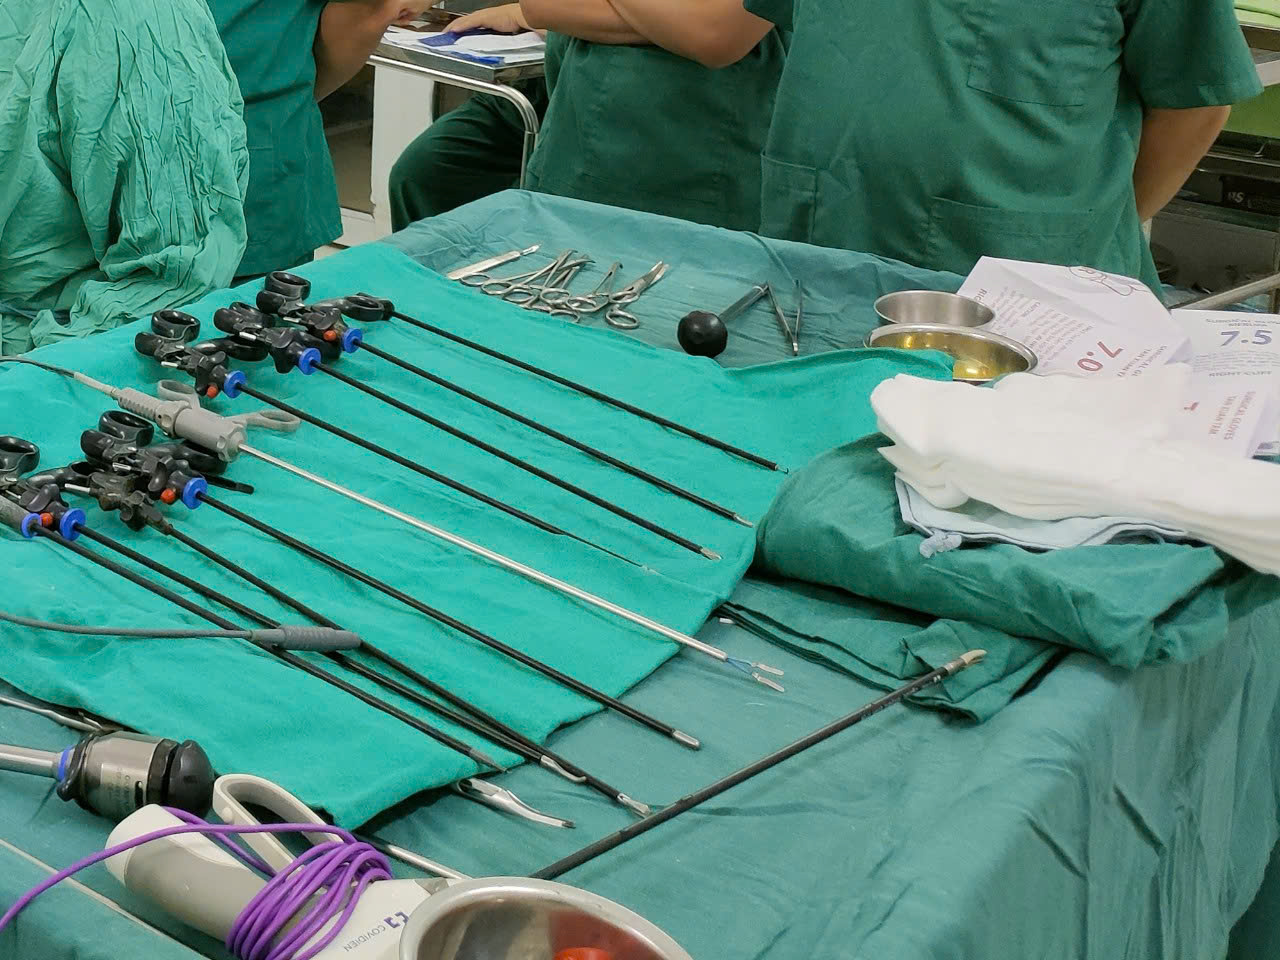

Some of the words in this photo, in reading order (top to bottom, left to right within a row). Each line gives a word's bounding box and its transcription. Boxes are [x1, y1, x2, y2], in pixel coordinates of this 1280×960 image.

[1221, 330, 1272, 346] 7.5
[1077, 341, 1125, 372] 7.0
[343, 924, 386, 952] COVIDIEN
